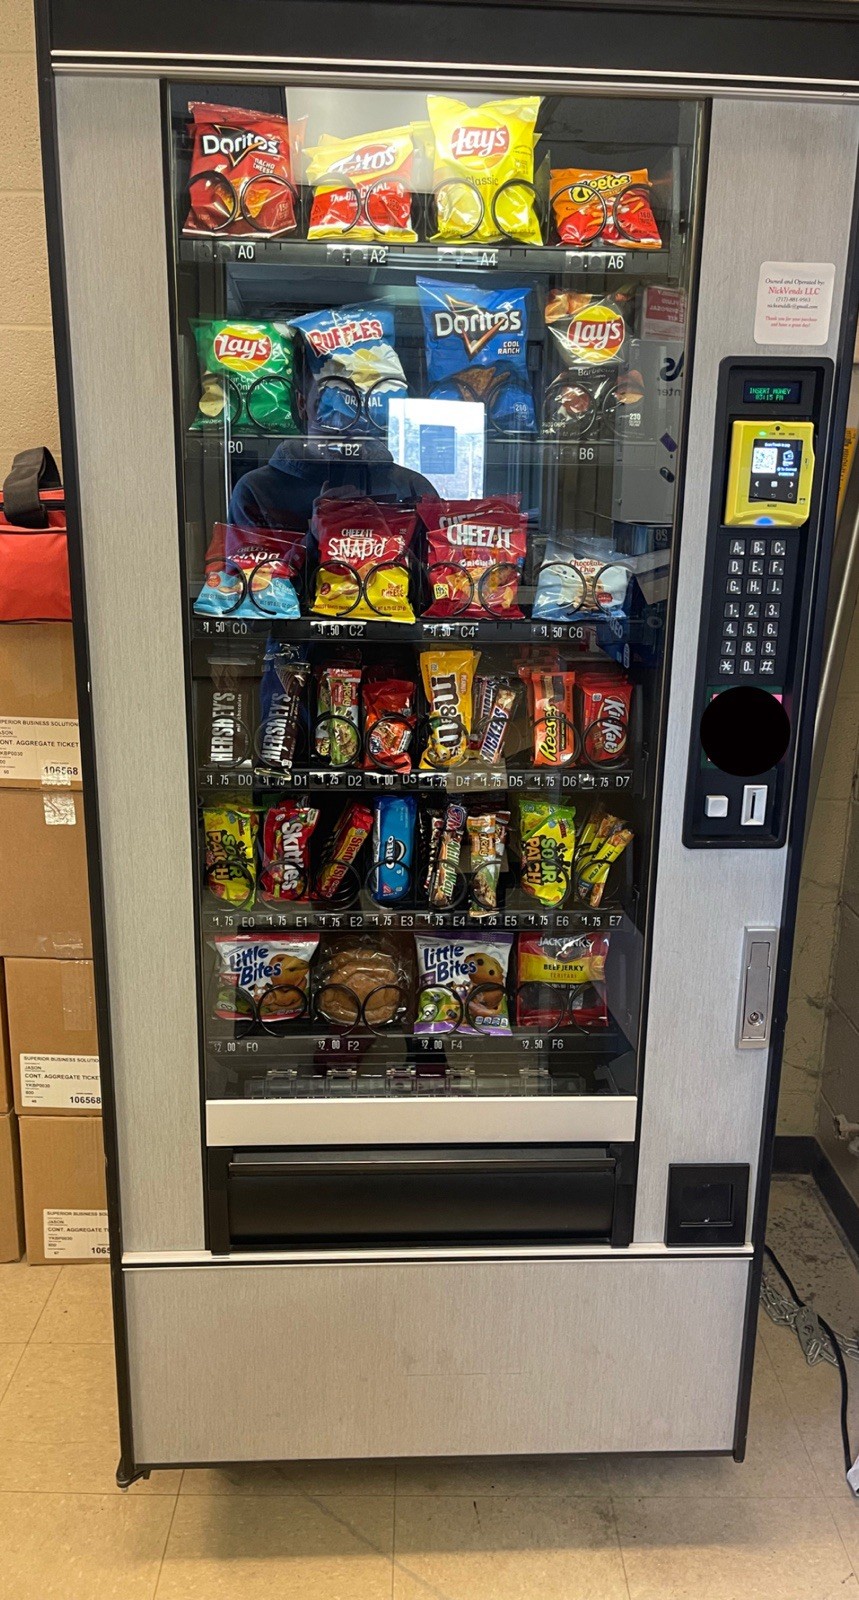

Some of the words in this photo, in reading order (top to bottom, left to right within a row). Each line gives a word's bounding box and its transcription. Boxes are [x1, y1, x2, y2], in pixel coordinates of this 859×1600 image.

[202, 134, 278, 155] Doritos
[452, 126, 507, 157] Lay's
[254, 158, 276, 170] NACHO
[237, 245, 254, 259] A0
[370, 250, 386, 263] A2
[480, 252, 496, 267] A4
[607, 255, 624, 270] A6
[765, 277, 783, 285] Owned
[794, 278, 817, 286] Operated
[768, 286, 803, 295] NickVends
[804, 287, 821, 295] LLC
[435, 309, 521, 337] Doritos
[308, 319, 384, 357] RUFFLES
[571, 320, 622, 350] Lay's
[217, 334, 271, 360] Lay's
[497, 347, 520, 355] RANCH
[749, 387, 771, 395] INSERT
[772, 387, 792, 395] MONEY
[229, 441, 243, 454] B0
[345, 443, 359, 457] B2
[579, 448, 593, 462] B6
[579, 565, 596, 574] Chip
[232, 622, 247, 635] C0
[349, 625, 364, 637] C2
[460, 626, 475, 638] C4
[568, 626, 584, 638] C6
[210, 692, 236, 762] HERSHEY'S
[261, 692, 291, 760] HERSHEY'S
[16, 740, 55, 748] AGGREGATE
[44, 766, 79, 776] 106568
[238, 774, 253, 786] D0
[294, 774, 307, 786] D1
[347, 775, 362, 787] D2
[402, 773, 417, 785] D3
[456, 775, 470, 787] D4
[508, 775, 523, 787] D5
[562, 775, 577, 787] D6
[615, 775, 630, 787] D7
[281, 821, 305, 891] Skittles
[526, 835, 542, 885] PATCH
[540, 836, 558, 883] SOUR
[241, 917, 255, 928] E0
[296, 916, 307, 928] E1
[350, 916, 363, 927] E2
[400, 915, 414, 927] E3
[452, 915, 466, 928] E4
[504, 915, 517, 927] E5
[556, 915, 569, 927] E6
[609, 915, 622, 927] E7
[537, 936, 560, 947] JACK
[229, 945, 269, 973] Little
[423, 944, 465, 971] Little
[436, 960, 477, 983] Bites
[543, 963, 561, 972] BEEF
[561, 964, 585, 973] JERKY
[240, 962, 282, 987] Bites
[246, 1041, 258, 1053] F0
[347, 1040, 360, 1052] F2
[451, 1039, 463, 1050] F4
[551, 1038, 564, 1050] F6
[69, 1096, 102, 1105] 106568
